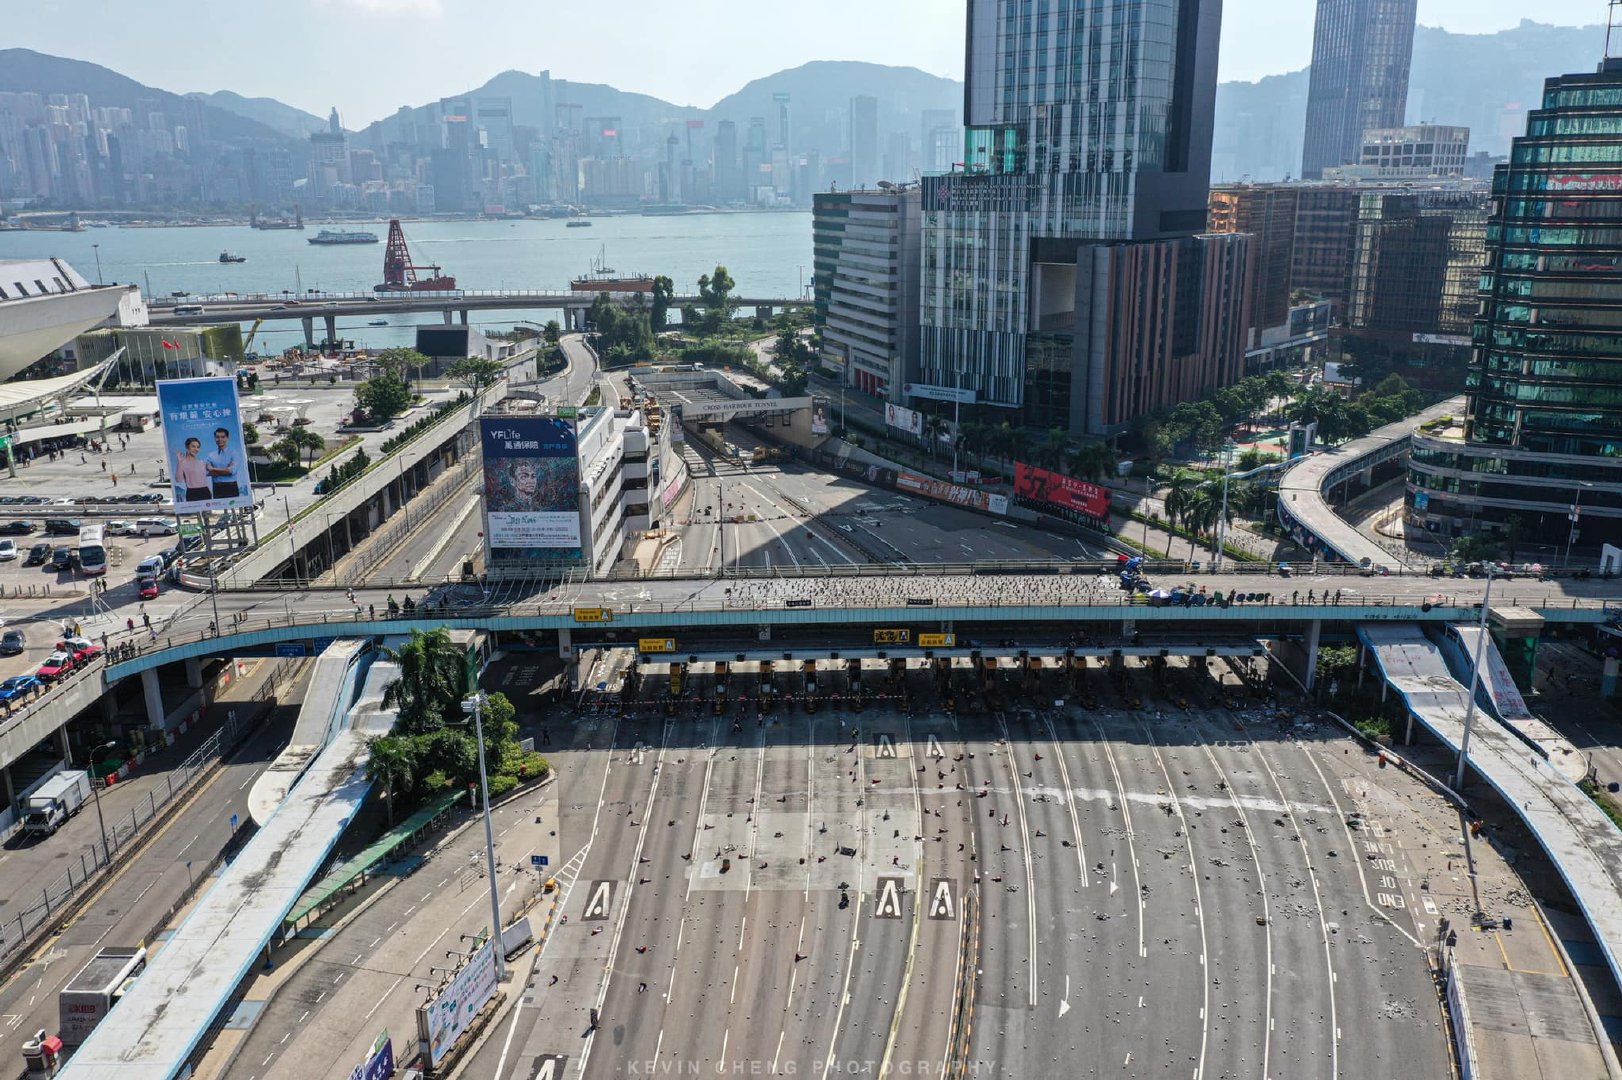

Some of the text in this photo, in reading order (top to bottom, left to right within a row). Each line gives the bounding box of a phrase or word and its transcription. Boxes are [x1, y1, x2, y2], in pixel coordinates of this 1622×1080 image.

[702, 403, 722, 411] CROSS
[723, 401, 752, 410] HARBOUR
[491, 428, 521, 440] YFLife
[1362, 840, 1394, 855] LANE
[1371, 859, 1397, 872] BUS
[1380, 875, 1396, 889] OF
[1378, 892, 1405, 908] END
